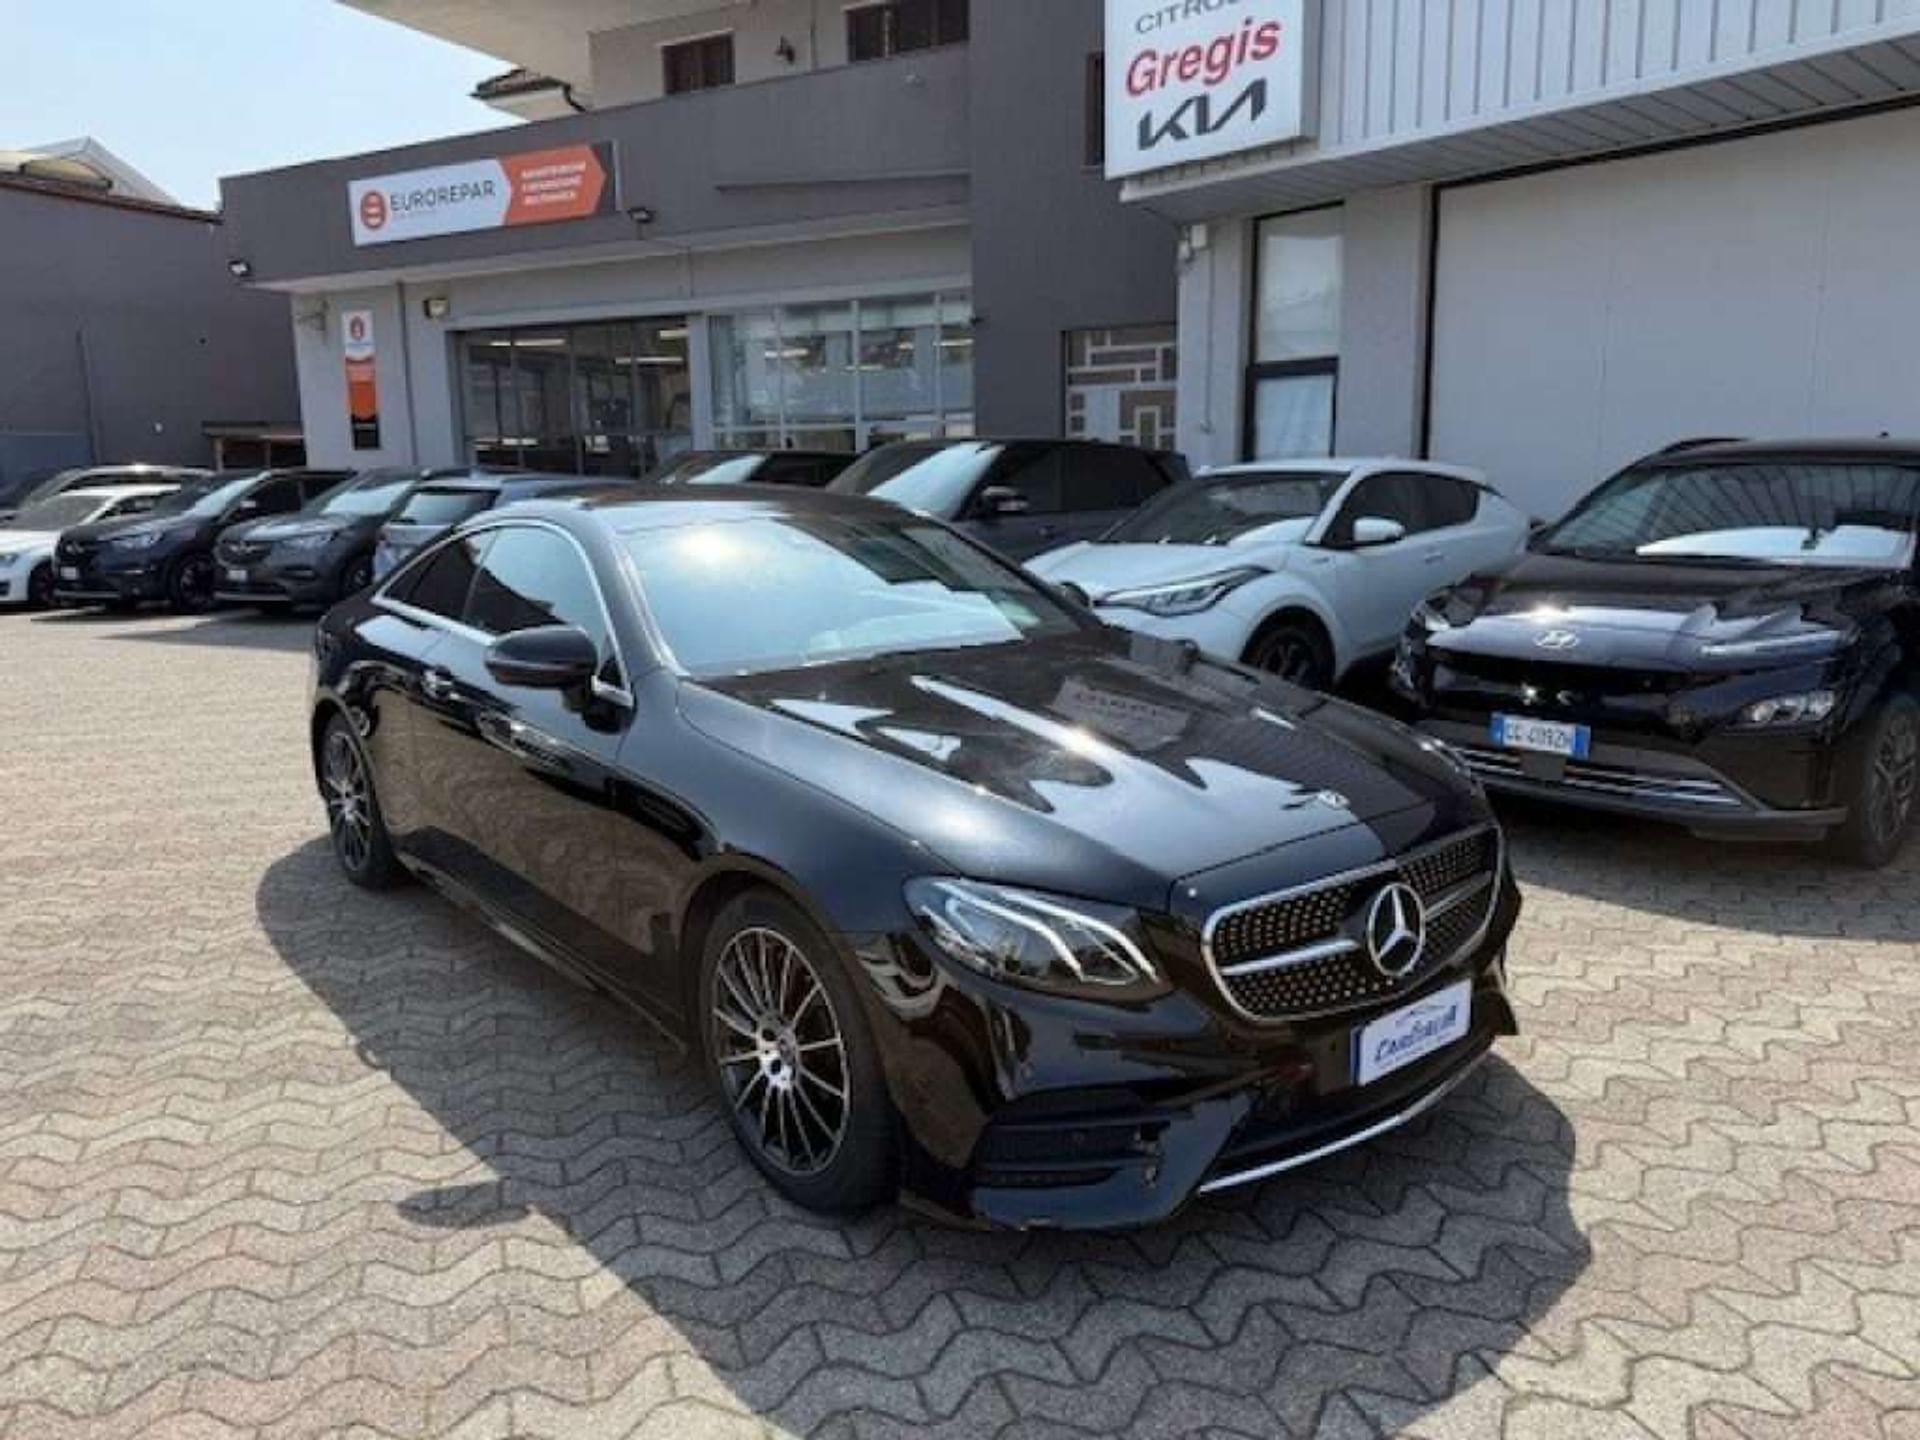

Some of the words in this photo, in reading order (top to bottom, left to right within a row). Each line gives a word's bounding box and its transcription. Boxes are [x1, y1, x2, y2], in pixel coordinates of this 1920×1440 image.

[1126, 17, 1280, 97] Gregis
[1138, 77, 1267, 151] KIA
[389, 180, 497, 213] EUROREPAR
